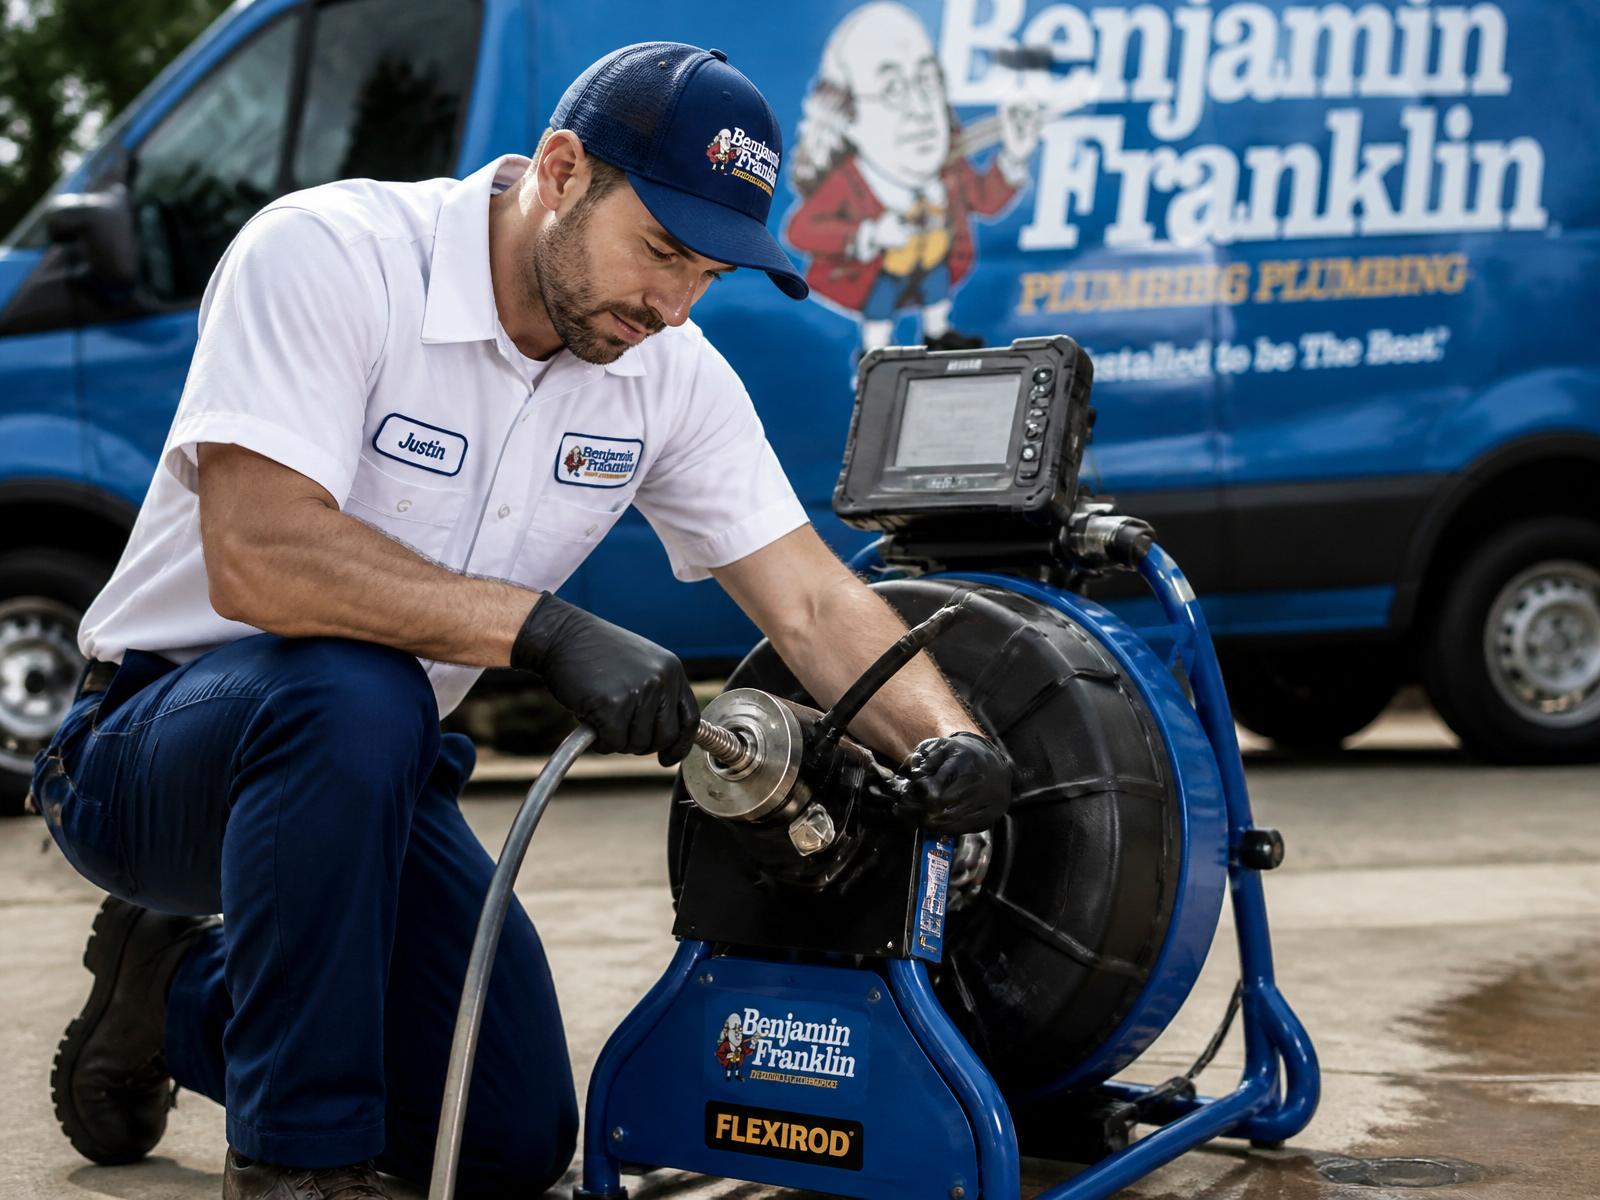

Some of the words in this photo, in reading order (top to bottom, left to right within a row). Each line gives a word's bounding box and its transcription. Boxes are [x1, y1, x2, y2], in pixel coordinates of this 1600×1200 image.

[938, 0, 1511, 140] Benjamin
[1018, 105, 1549, 252] Franklin
[1215, 340, 1250, 374] to
[1253, 336, 1296, 373] be
[1300, 331, 1363, 370] The
[398, 432, 446, 460] Justin
[742, 1007, 850, 1047] Benjamin
[752, 1039, 856, 1078] Franklin
